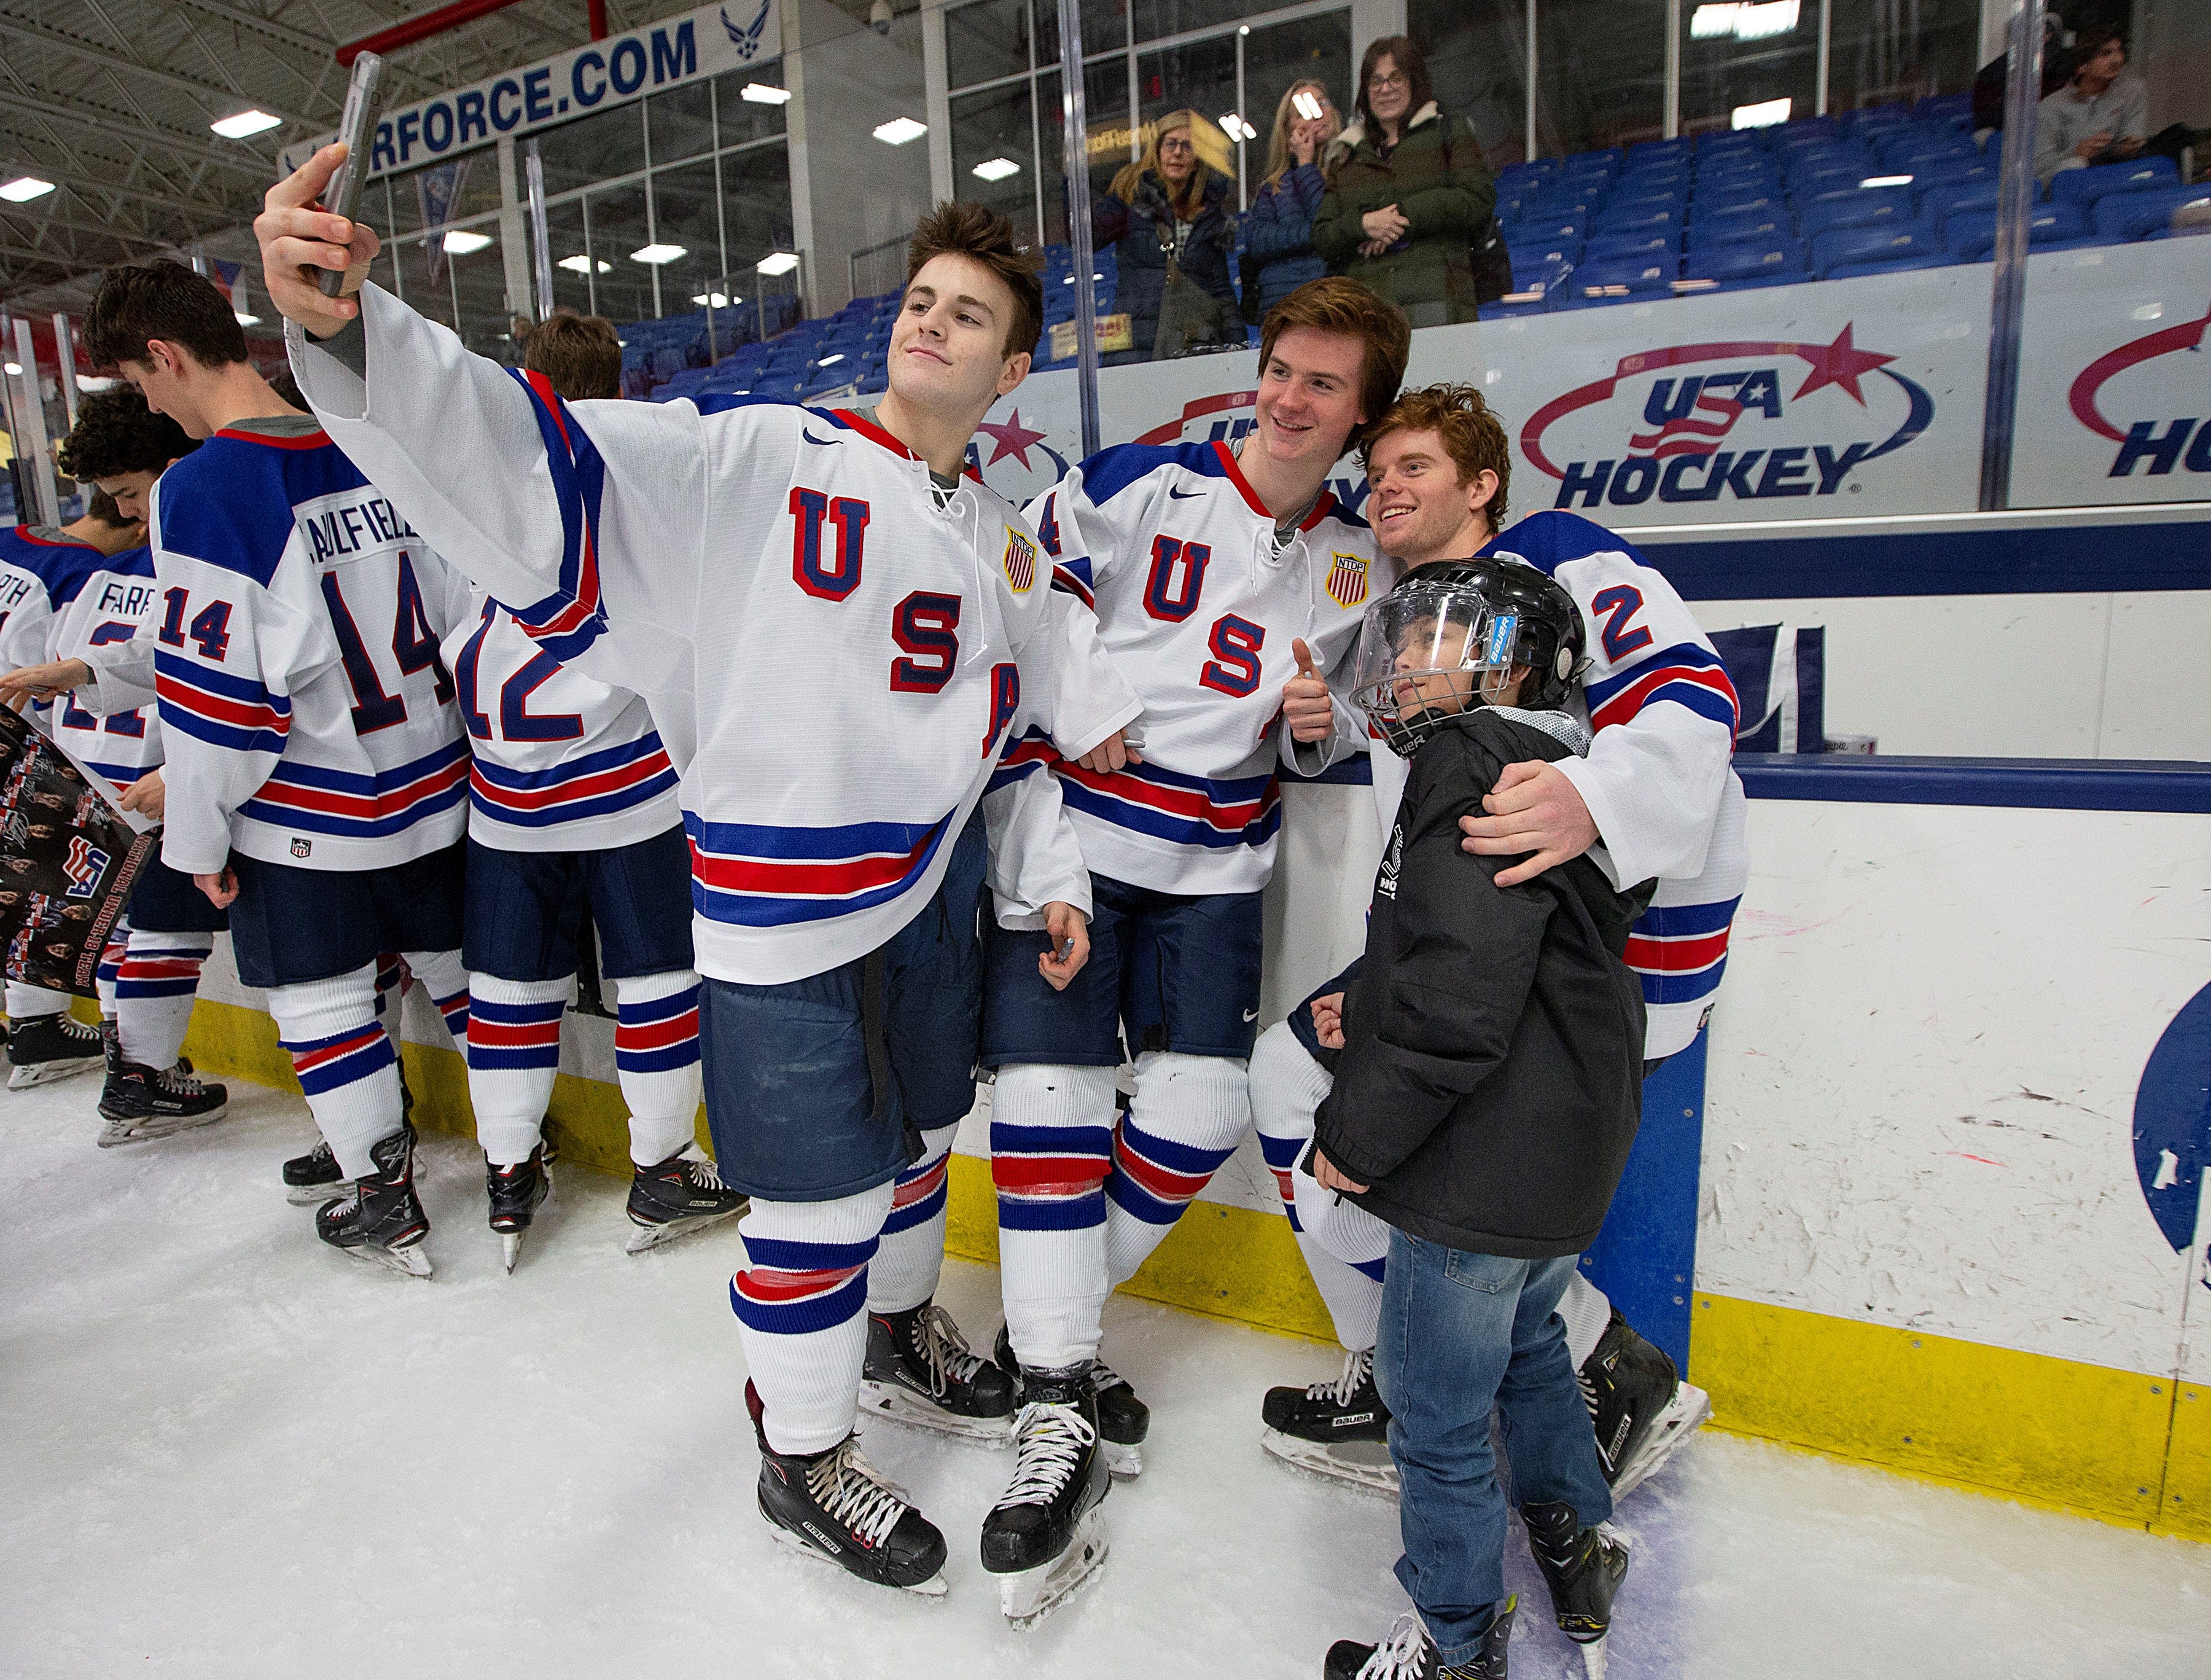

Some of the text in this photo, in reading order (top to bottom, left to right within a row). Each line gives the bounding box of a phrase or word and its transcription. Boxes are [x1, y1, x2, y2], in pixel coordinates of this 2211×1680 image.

[333, 18, 697, 171] RFORCE.COM
[1631, 369, 1783, 448] USA
[1553, 442, 1875, 509] HOCKEY
[298, 498, 420, 565] AULFIEL
[1013, 533, 1033, 555] NTDP
[1338, 558, 1363, 571] NTDP
[158, 587, 233, 663] 14
[321, 551, 456, 737] 14
[1591, 584, 1654, 665] 2
[454, 595, 585, 742] 12
[63, 835, 111, 899] USA
[76, 834, 152, 988] NATIONAL UNDER-18 TEAM
